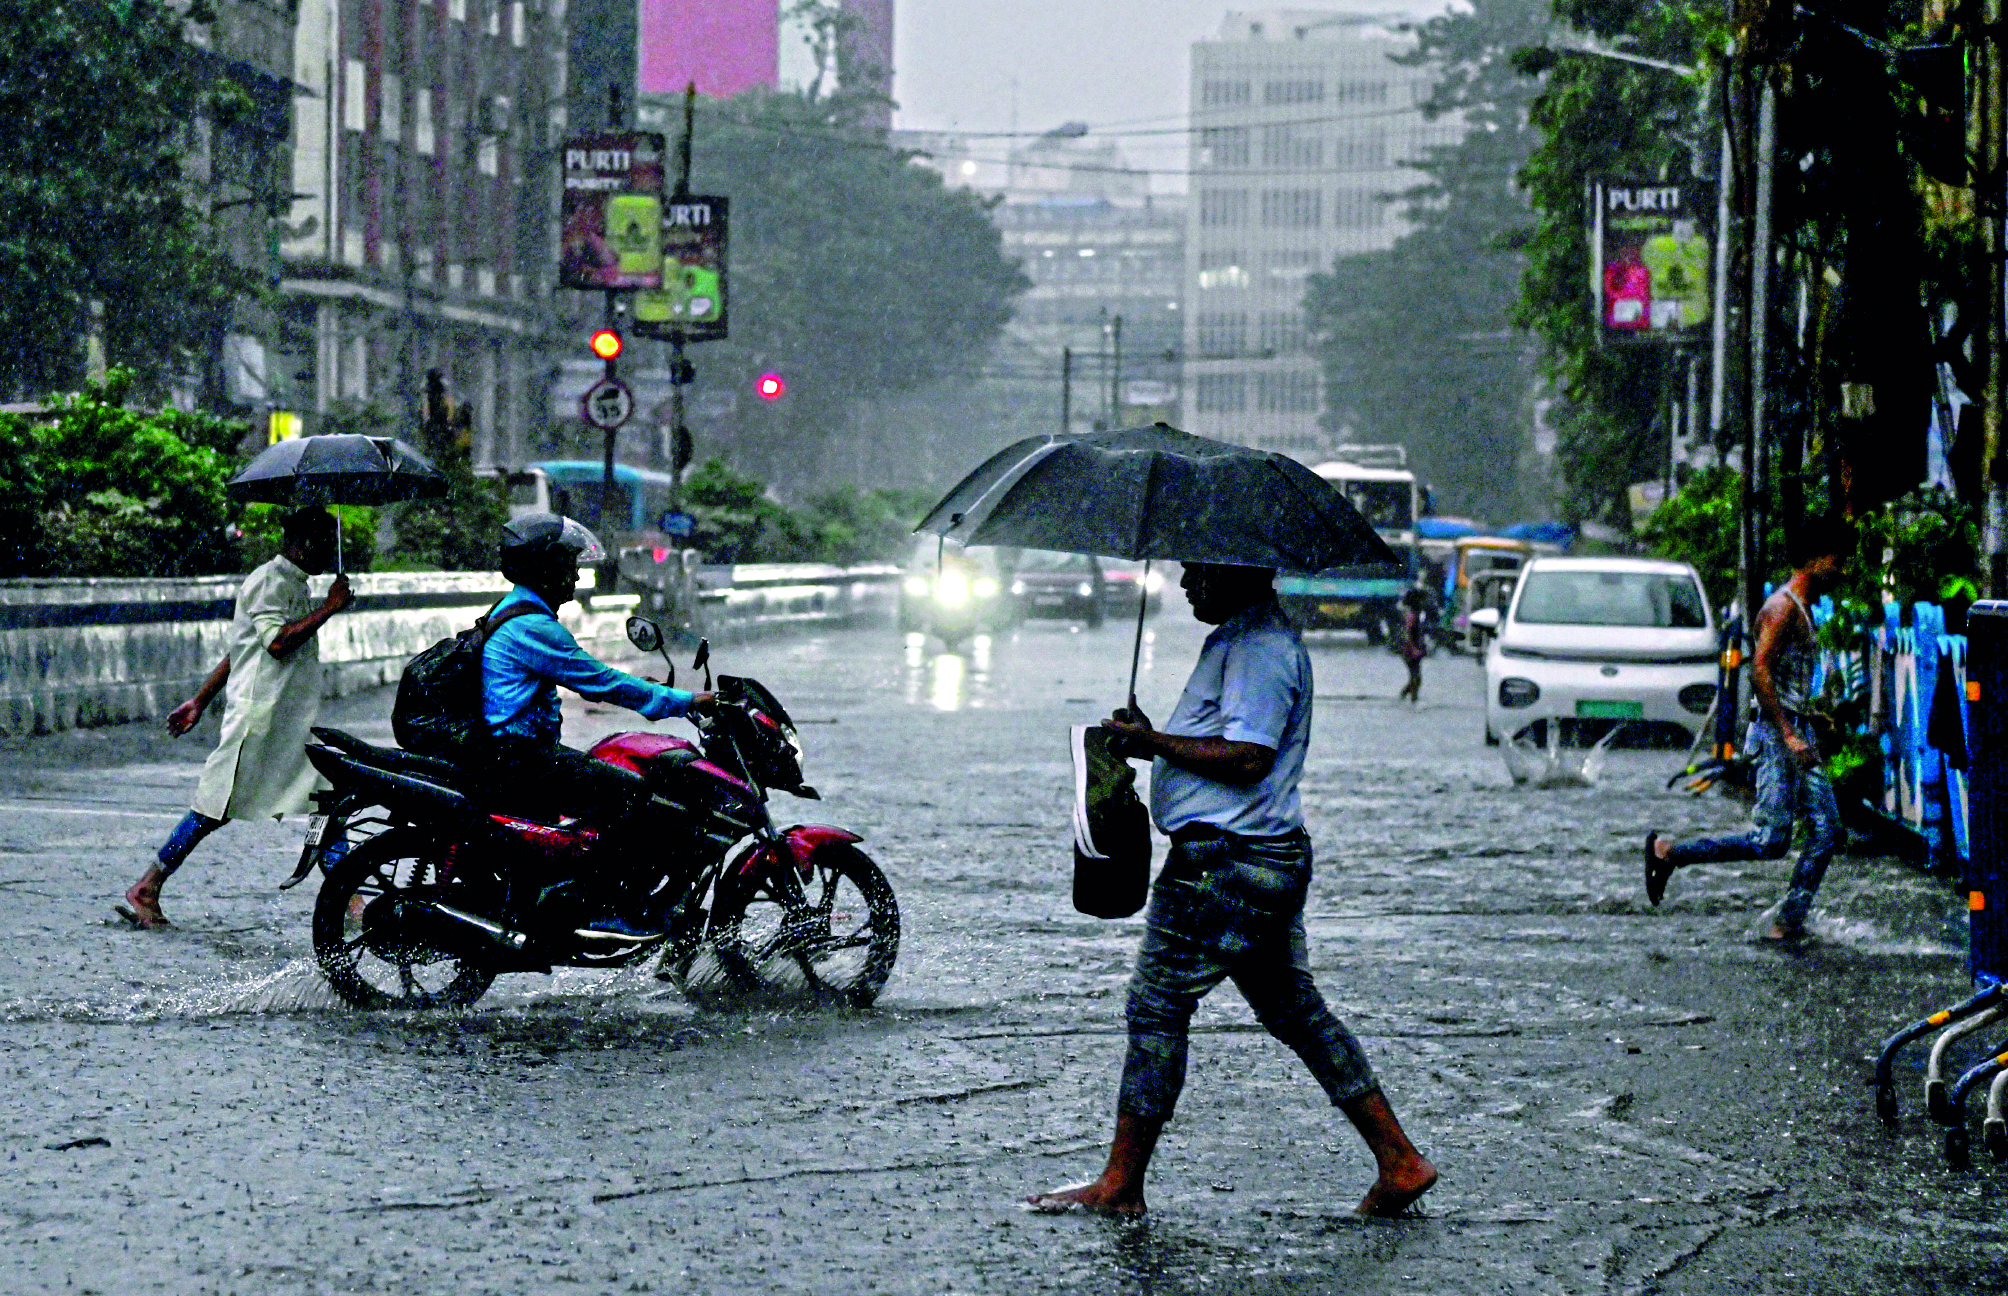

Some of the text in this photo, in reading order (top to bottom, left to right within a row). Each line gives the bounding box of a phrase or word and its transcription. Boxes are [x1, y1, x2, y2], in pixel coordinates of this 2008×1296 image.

[566, 149, 630, 171] PURTI
[1608, 188, 1679, 211] PURTI
[663, 204, 711, 227] URTI
